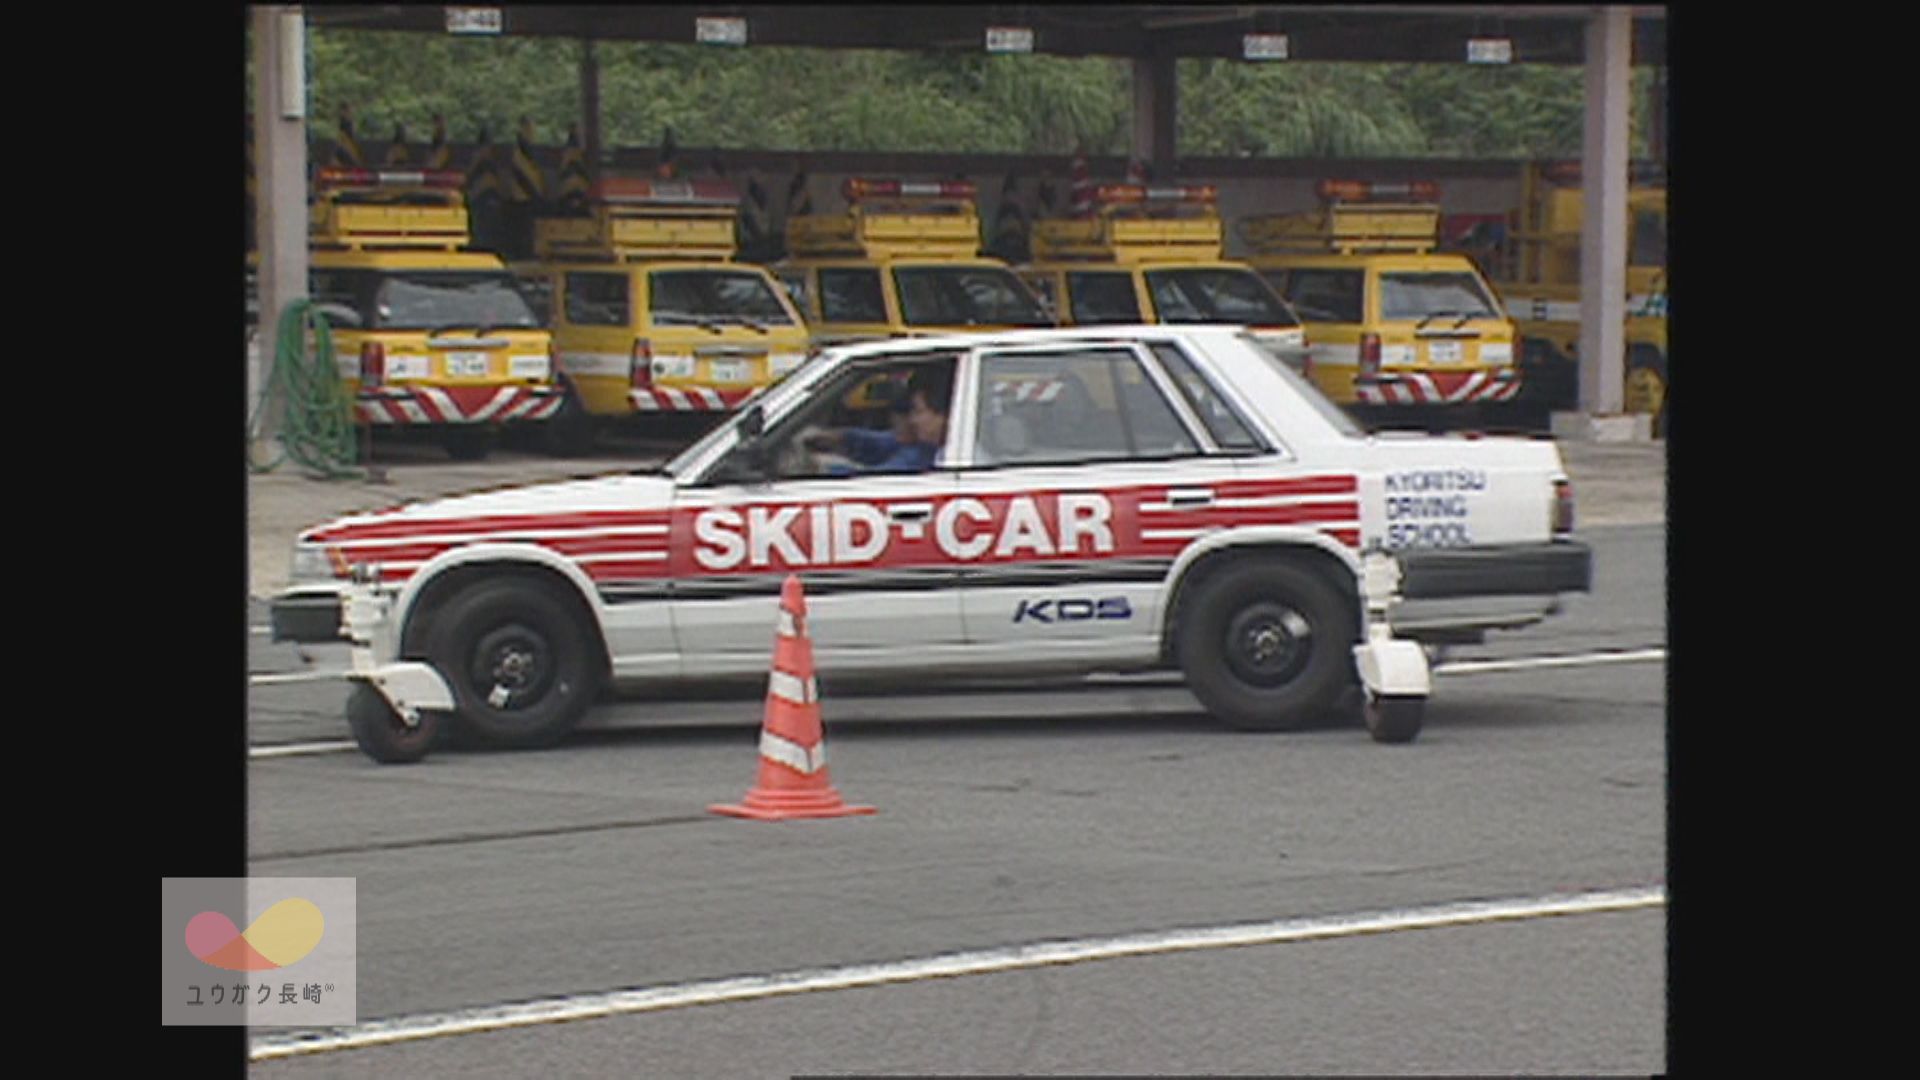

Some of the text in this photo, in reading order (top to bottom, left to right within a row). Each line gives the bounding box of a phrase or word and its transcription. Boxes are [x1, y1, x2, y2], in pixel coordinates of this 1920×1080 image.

[1384, 469, 1486, 492] KYORITSU
[1385, 494, 1467, 519] DRIVING
[1387, 522, 1472, 548] SCHOOL
[1012, 597, 1134, 624] KDS
